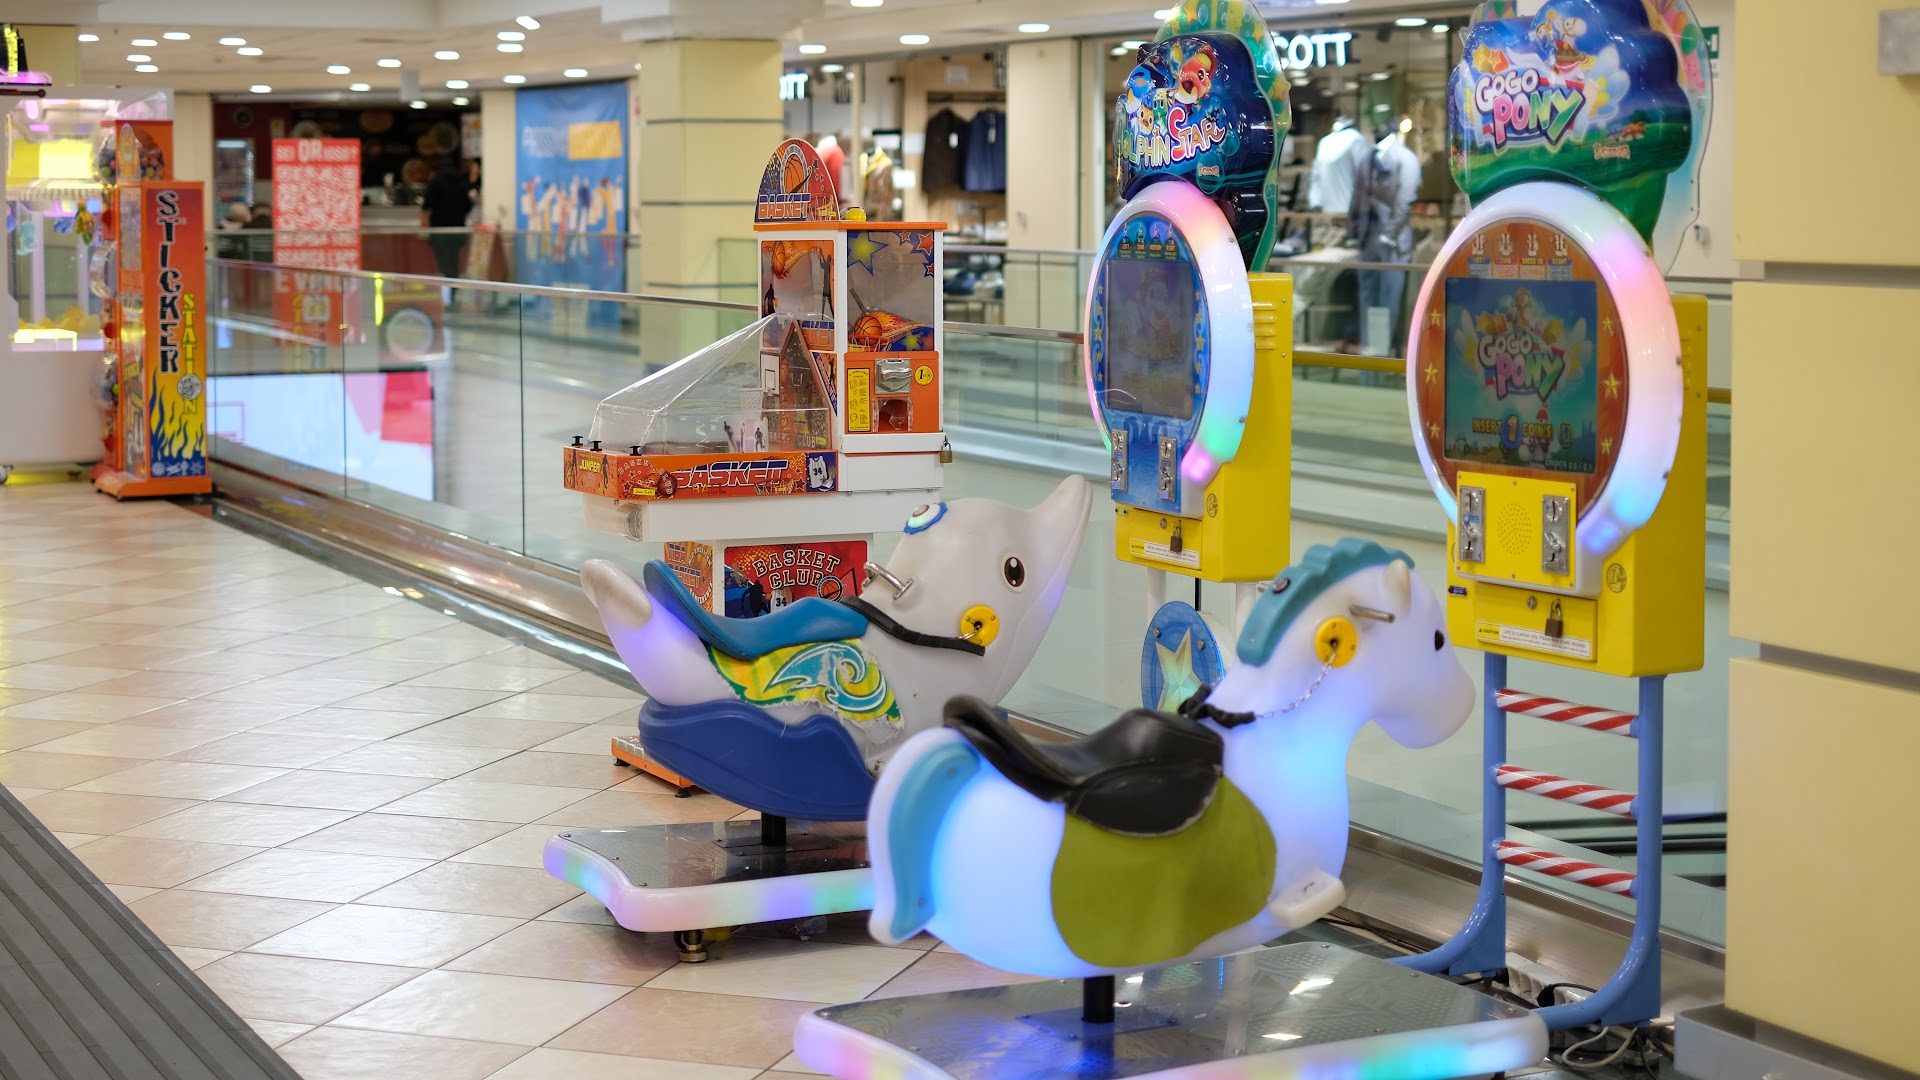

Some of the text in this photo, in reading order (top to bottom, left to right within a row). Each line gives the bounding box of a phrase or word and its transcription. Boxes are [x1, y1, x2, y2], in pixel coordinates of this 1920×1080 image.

[1475, 68, 1539, 112] GOGO
[1493, 88, 1584, 145] PONY
[1168, 104, 1227, 162] STAR
[758, 193, 811, 219] BASKET
[157, 189, 182, 374] STICKER
[1478, 333, 1533, 368] GOGO
[1494, 352, 1565, 401] PONY
[1472, 418, 1503, 435] INSERT
[1506, 414, 1518, 442] 1
[579, 459, 601, 474] JUMPER
[670, 459, 789, 489] BASKET
[813, 467, 823, 476] 34
[692, 485, 727, 495] BALL
[752, 549, 840, 578] BASKET
[769, 569, 825, 590] CLUB
[775, 597, 788, 607] 34
